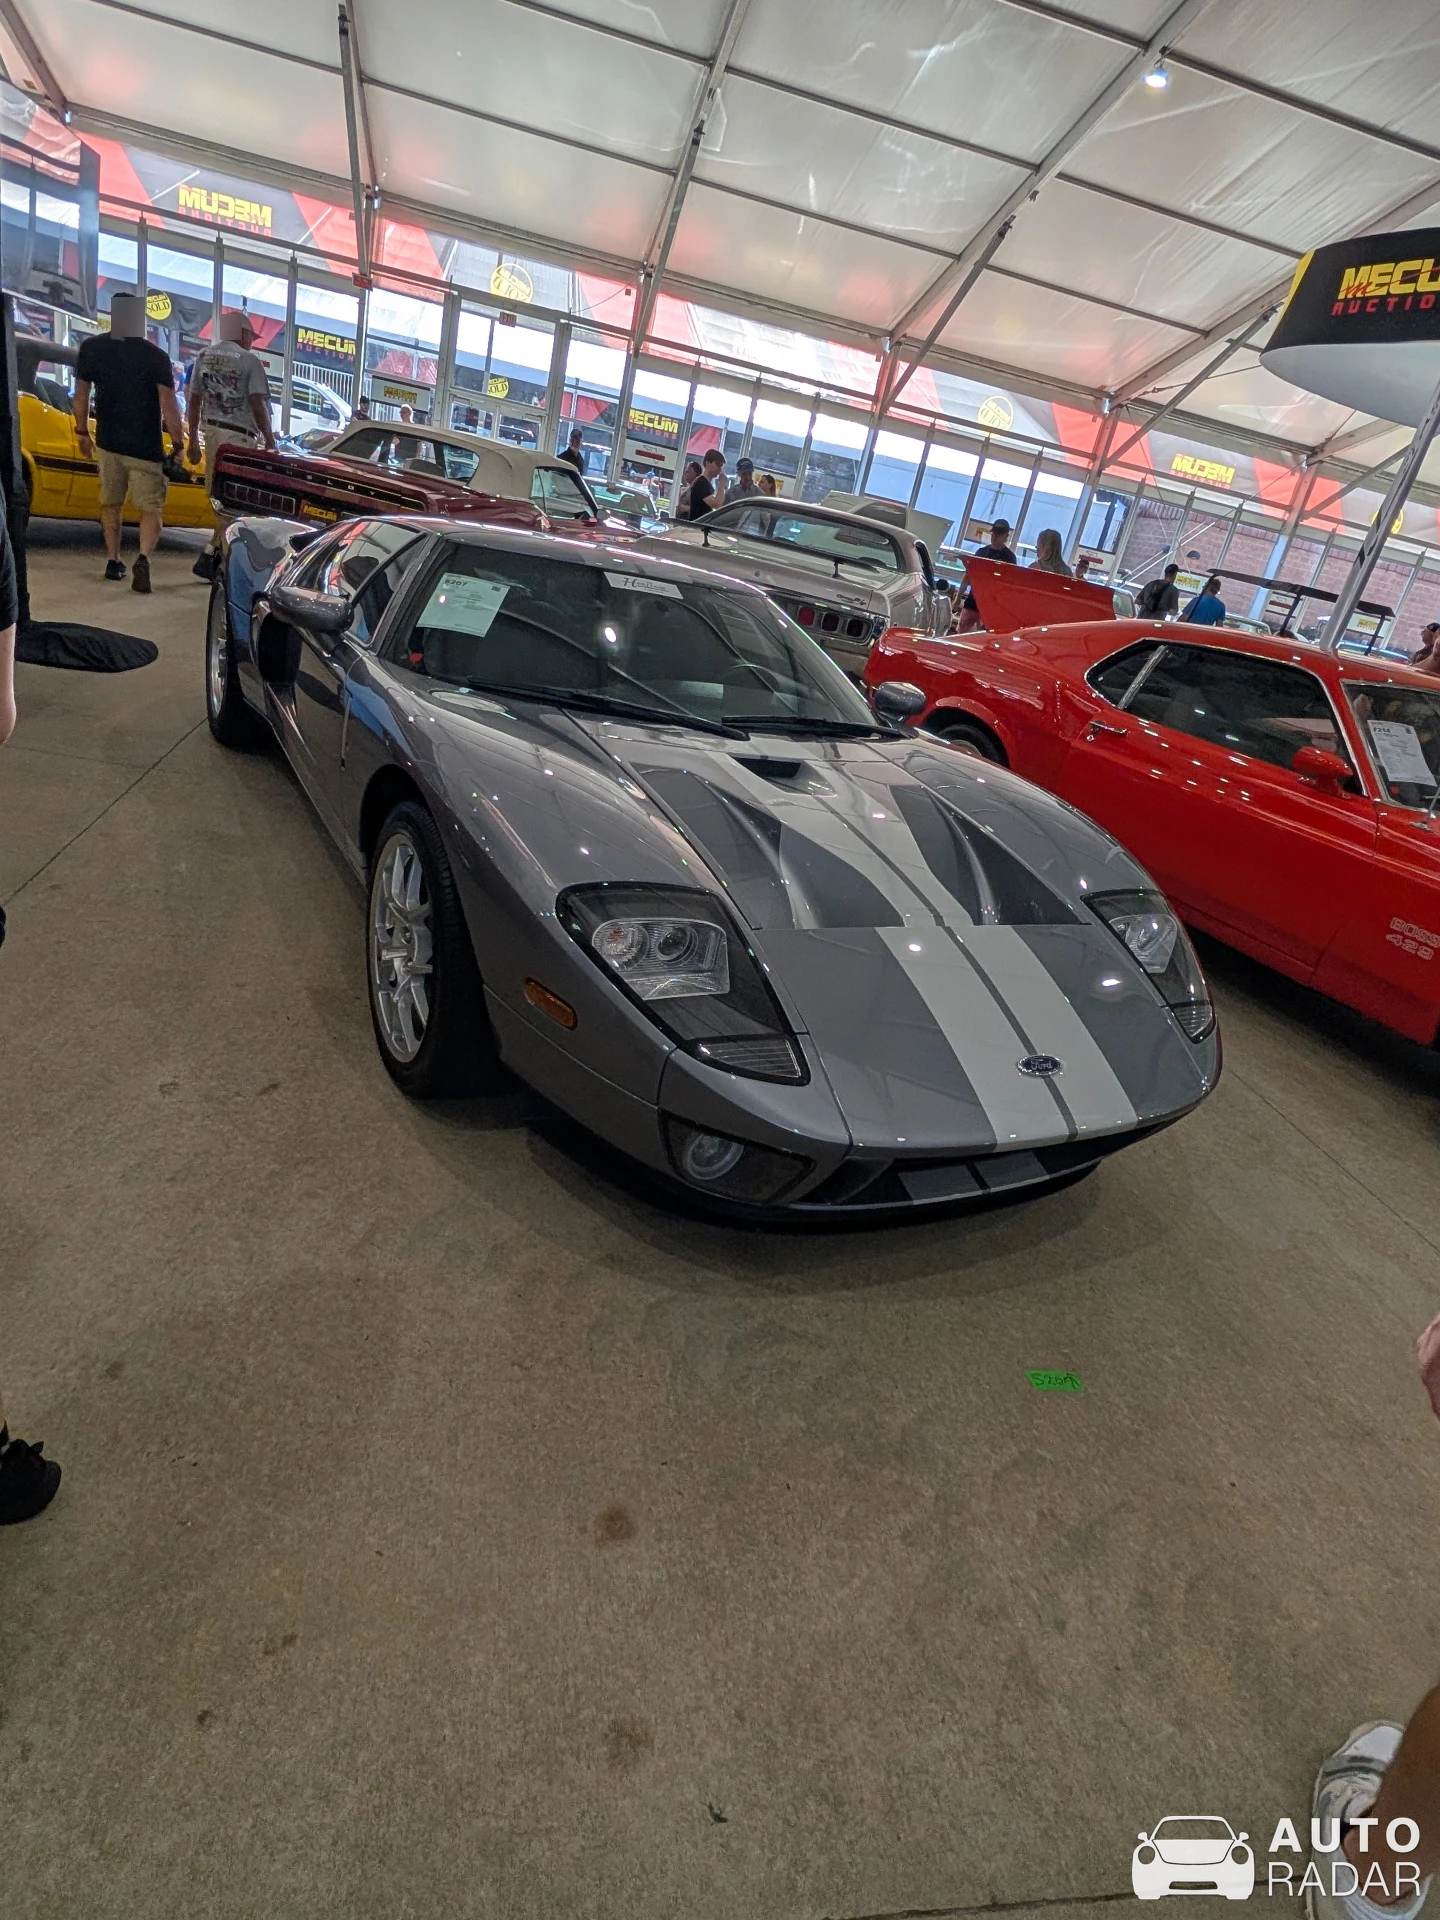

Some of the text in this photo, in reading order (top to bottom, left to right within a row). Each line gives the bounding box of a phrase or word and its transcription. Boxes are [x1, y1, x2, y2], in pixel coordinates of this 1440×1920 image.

[1338, 258, 1440, 300] MECU
[1331, 294, 1436, 316] AUCTIO
[296, 342, 355, 362] AUCTION
[626, 422, 678, 440] UCTIONS
[1390, 916, 1440, 948] BOSS
[1385, 933, 1435, 960] 429
